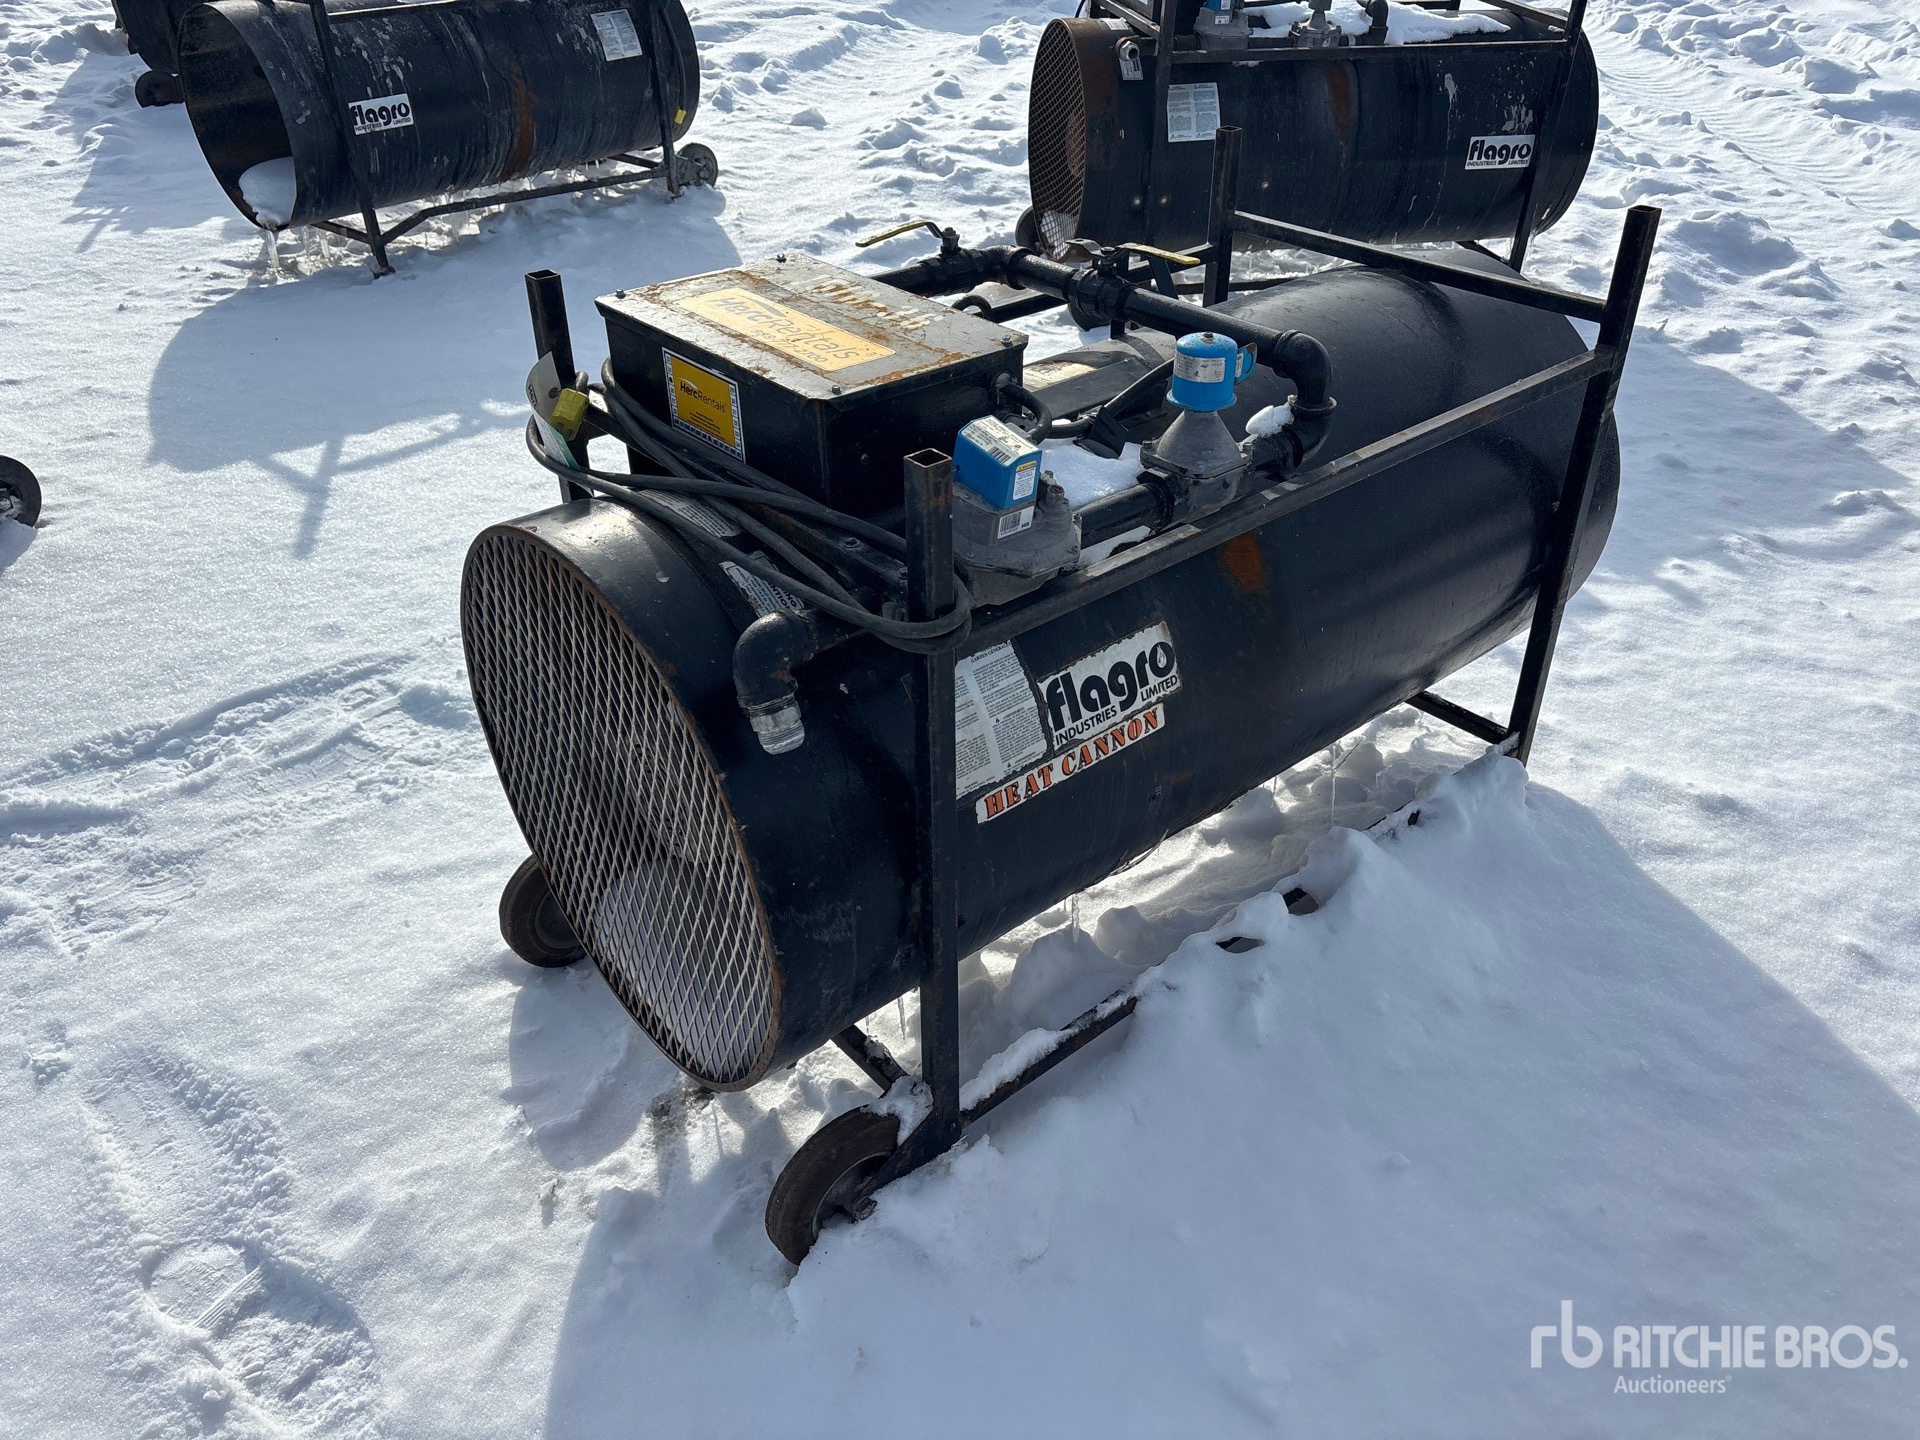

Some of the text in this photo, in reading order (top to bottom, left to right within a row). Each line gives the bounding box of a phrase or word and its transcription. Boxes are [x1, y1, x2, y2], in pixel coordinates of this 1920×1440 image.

[350, 102, 410, 127] flagro
[1468, 139, 1532, 166] flagro
[680, 381, 726, 413] HercRentals
[1045, 641, 1176, 732] flagro
[1055, 674, 1178, 746] INDUSTRIES LIMITED
[983, 763, 1054, 819] HEAT
[1061, 707, 1159, 776] CANNON
